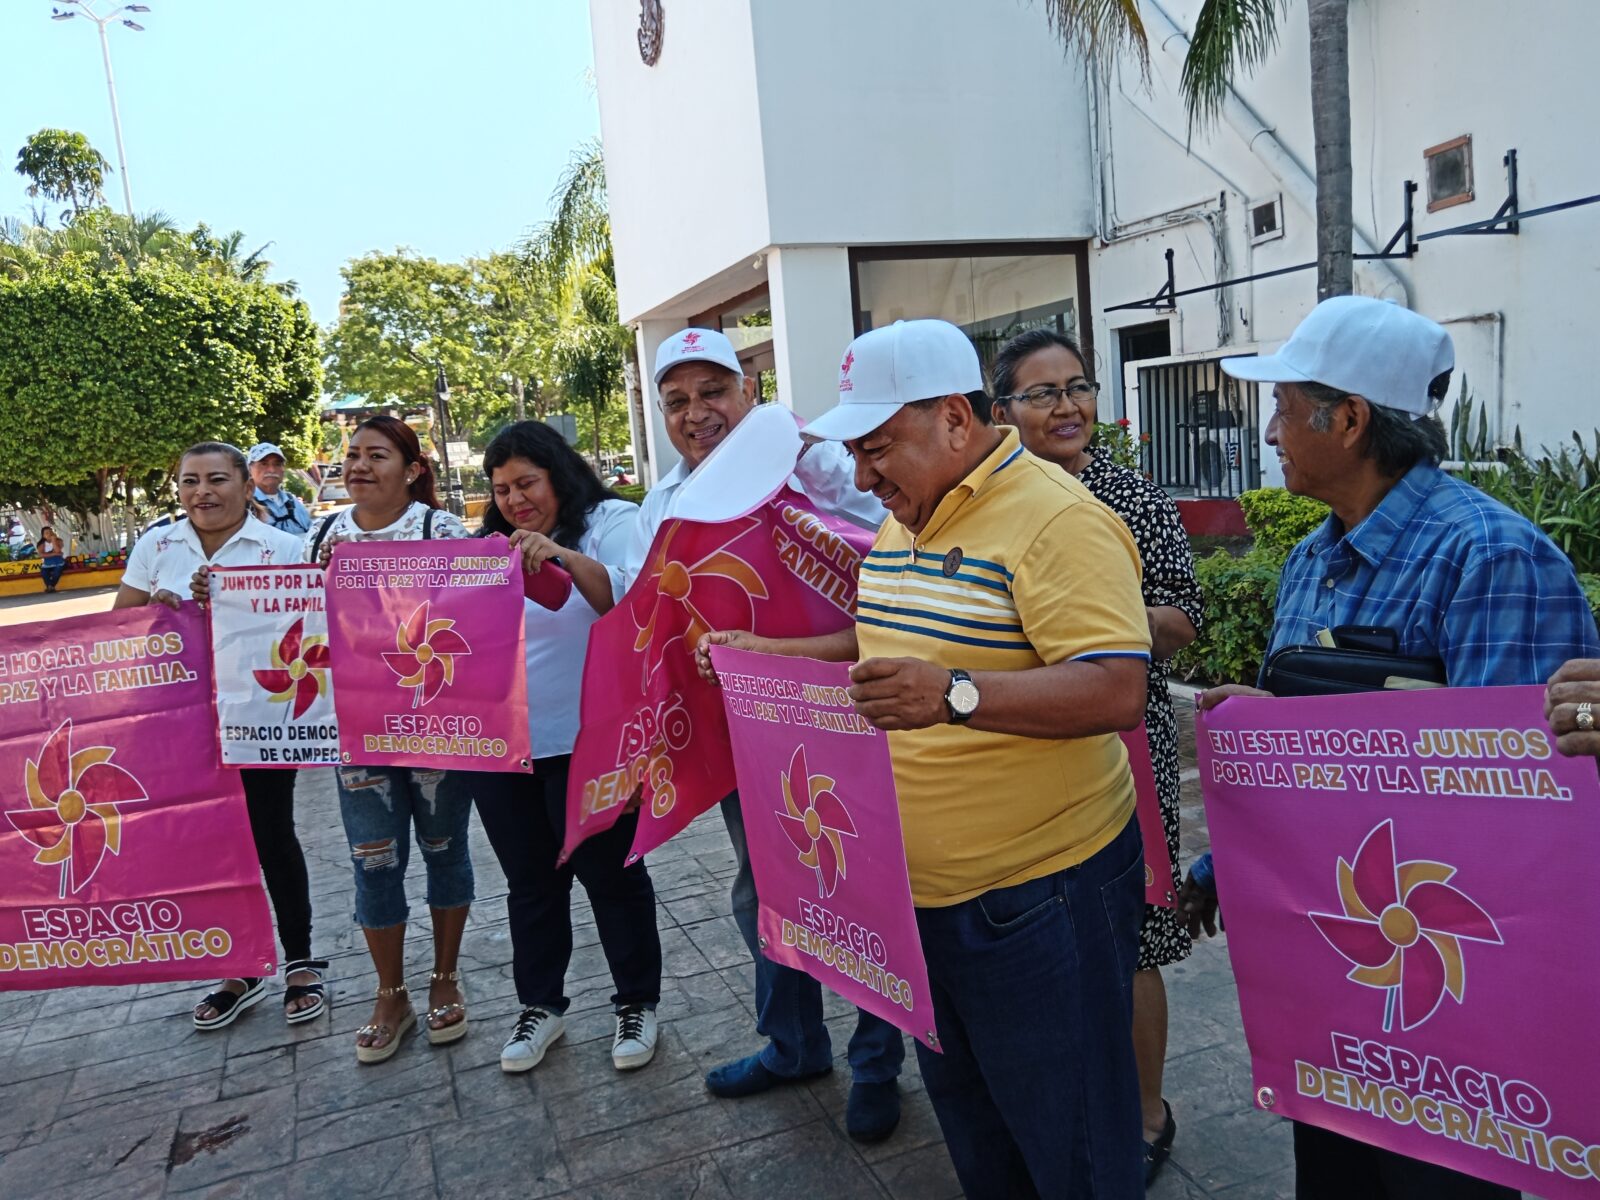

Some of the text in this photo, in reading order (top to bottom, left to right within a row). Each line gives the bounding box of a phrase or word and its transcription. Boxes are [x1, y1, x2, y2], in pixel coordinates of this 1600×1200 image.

[782, 505, 863, 582] JUNT
[336, 572, 509, 588] POR LA PAZ Y LA FAMILIA.
[339, 556, 510, 572] EN ESTE HOGAR JUNTOS
[221, 573, 324, 591] JUNTOS POR LA
[251, 597, 323, 613] Y LA FAMIL
[11, 645, 86, 674] HOGAR
[89, 632, 183, 664] JUNTOS
[0, 661, 197, 704] PAZ Y LA FAMILIA.
[732, 673, 757, 695] ESTE
[757, 678, 802, 701] HOGAR
[226, 725, 337, 740] ESPACIO DEMOC
[384, 715, 482, 737] ESPACIO
[739, 699, 755, 719] LA
[754, 701, 779, 722] PAZ
[778, 705, 790, 723] Y
[790, 706, 811, 726] LA
[809, 709, 876, 736] FAMILIA.
[260, 747, 341, 762] DE CAMPEC
[363, 733, 507, 758] DEMOCRÁTICO
[1208, 728, 1552, 760] EN ESTE HOGAR JUNTOS
[1212, 759, 1573, 801] POR LA PAZ Y LA FAMILIA.
[22, 899, 182, 940] ESPACIO
[799, 897, 887, 967] ESPACIO
[0, 927, 232, 972] DEMOCRÁTICO
[782, 918, 913, 1012] DEMOCRÁTICO
[1330, 1032, 1551, 1127] ESPACIO
